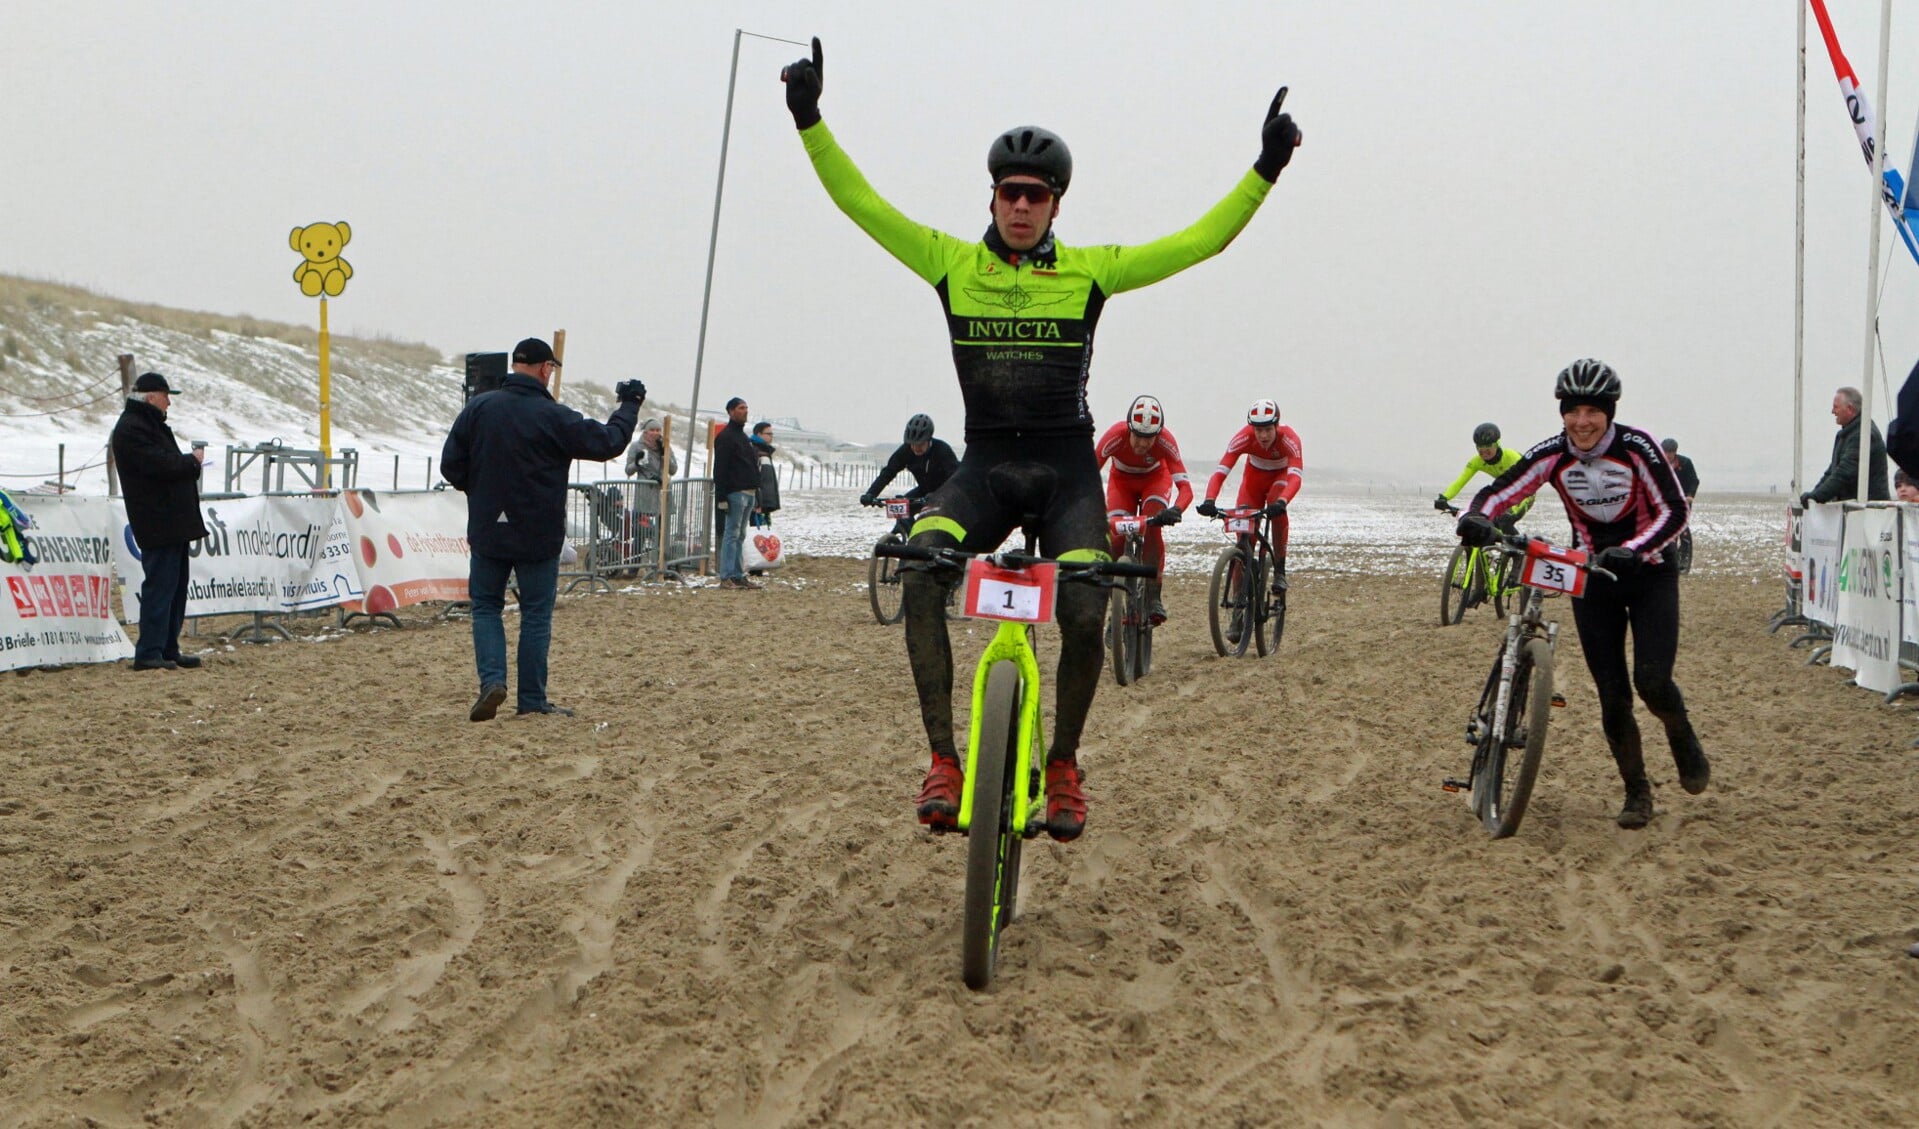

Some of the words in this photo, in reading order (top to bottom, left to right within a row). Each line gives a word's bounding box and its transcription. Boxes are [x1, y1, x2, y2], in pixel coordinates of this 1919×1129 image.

[968, 320, 1062, 338] INVICTA
[986, 351, 1044, 361] WATCHES
[1631, 433, 1661, 465] GIANT
[1586, 492, 1631, 506] GIANT
[1122, 522, 1135, 532] 16
[1543, 565, 1565, 582] 35
[1002, 590, 1015, 609] 1
[5, 631, 36, 651] Briele
